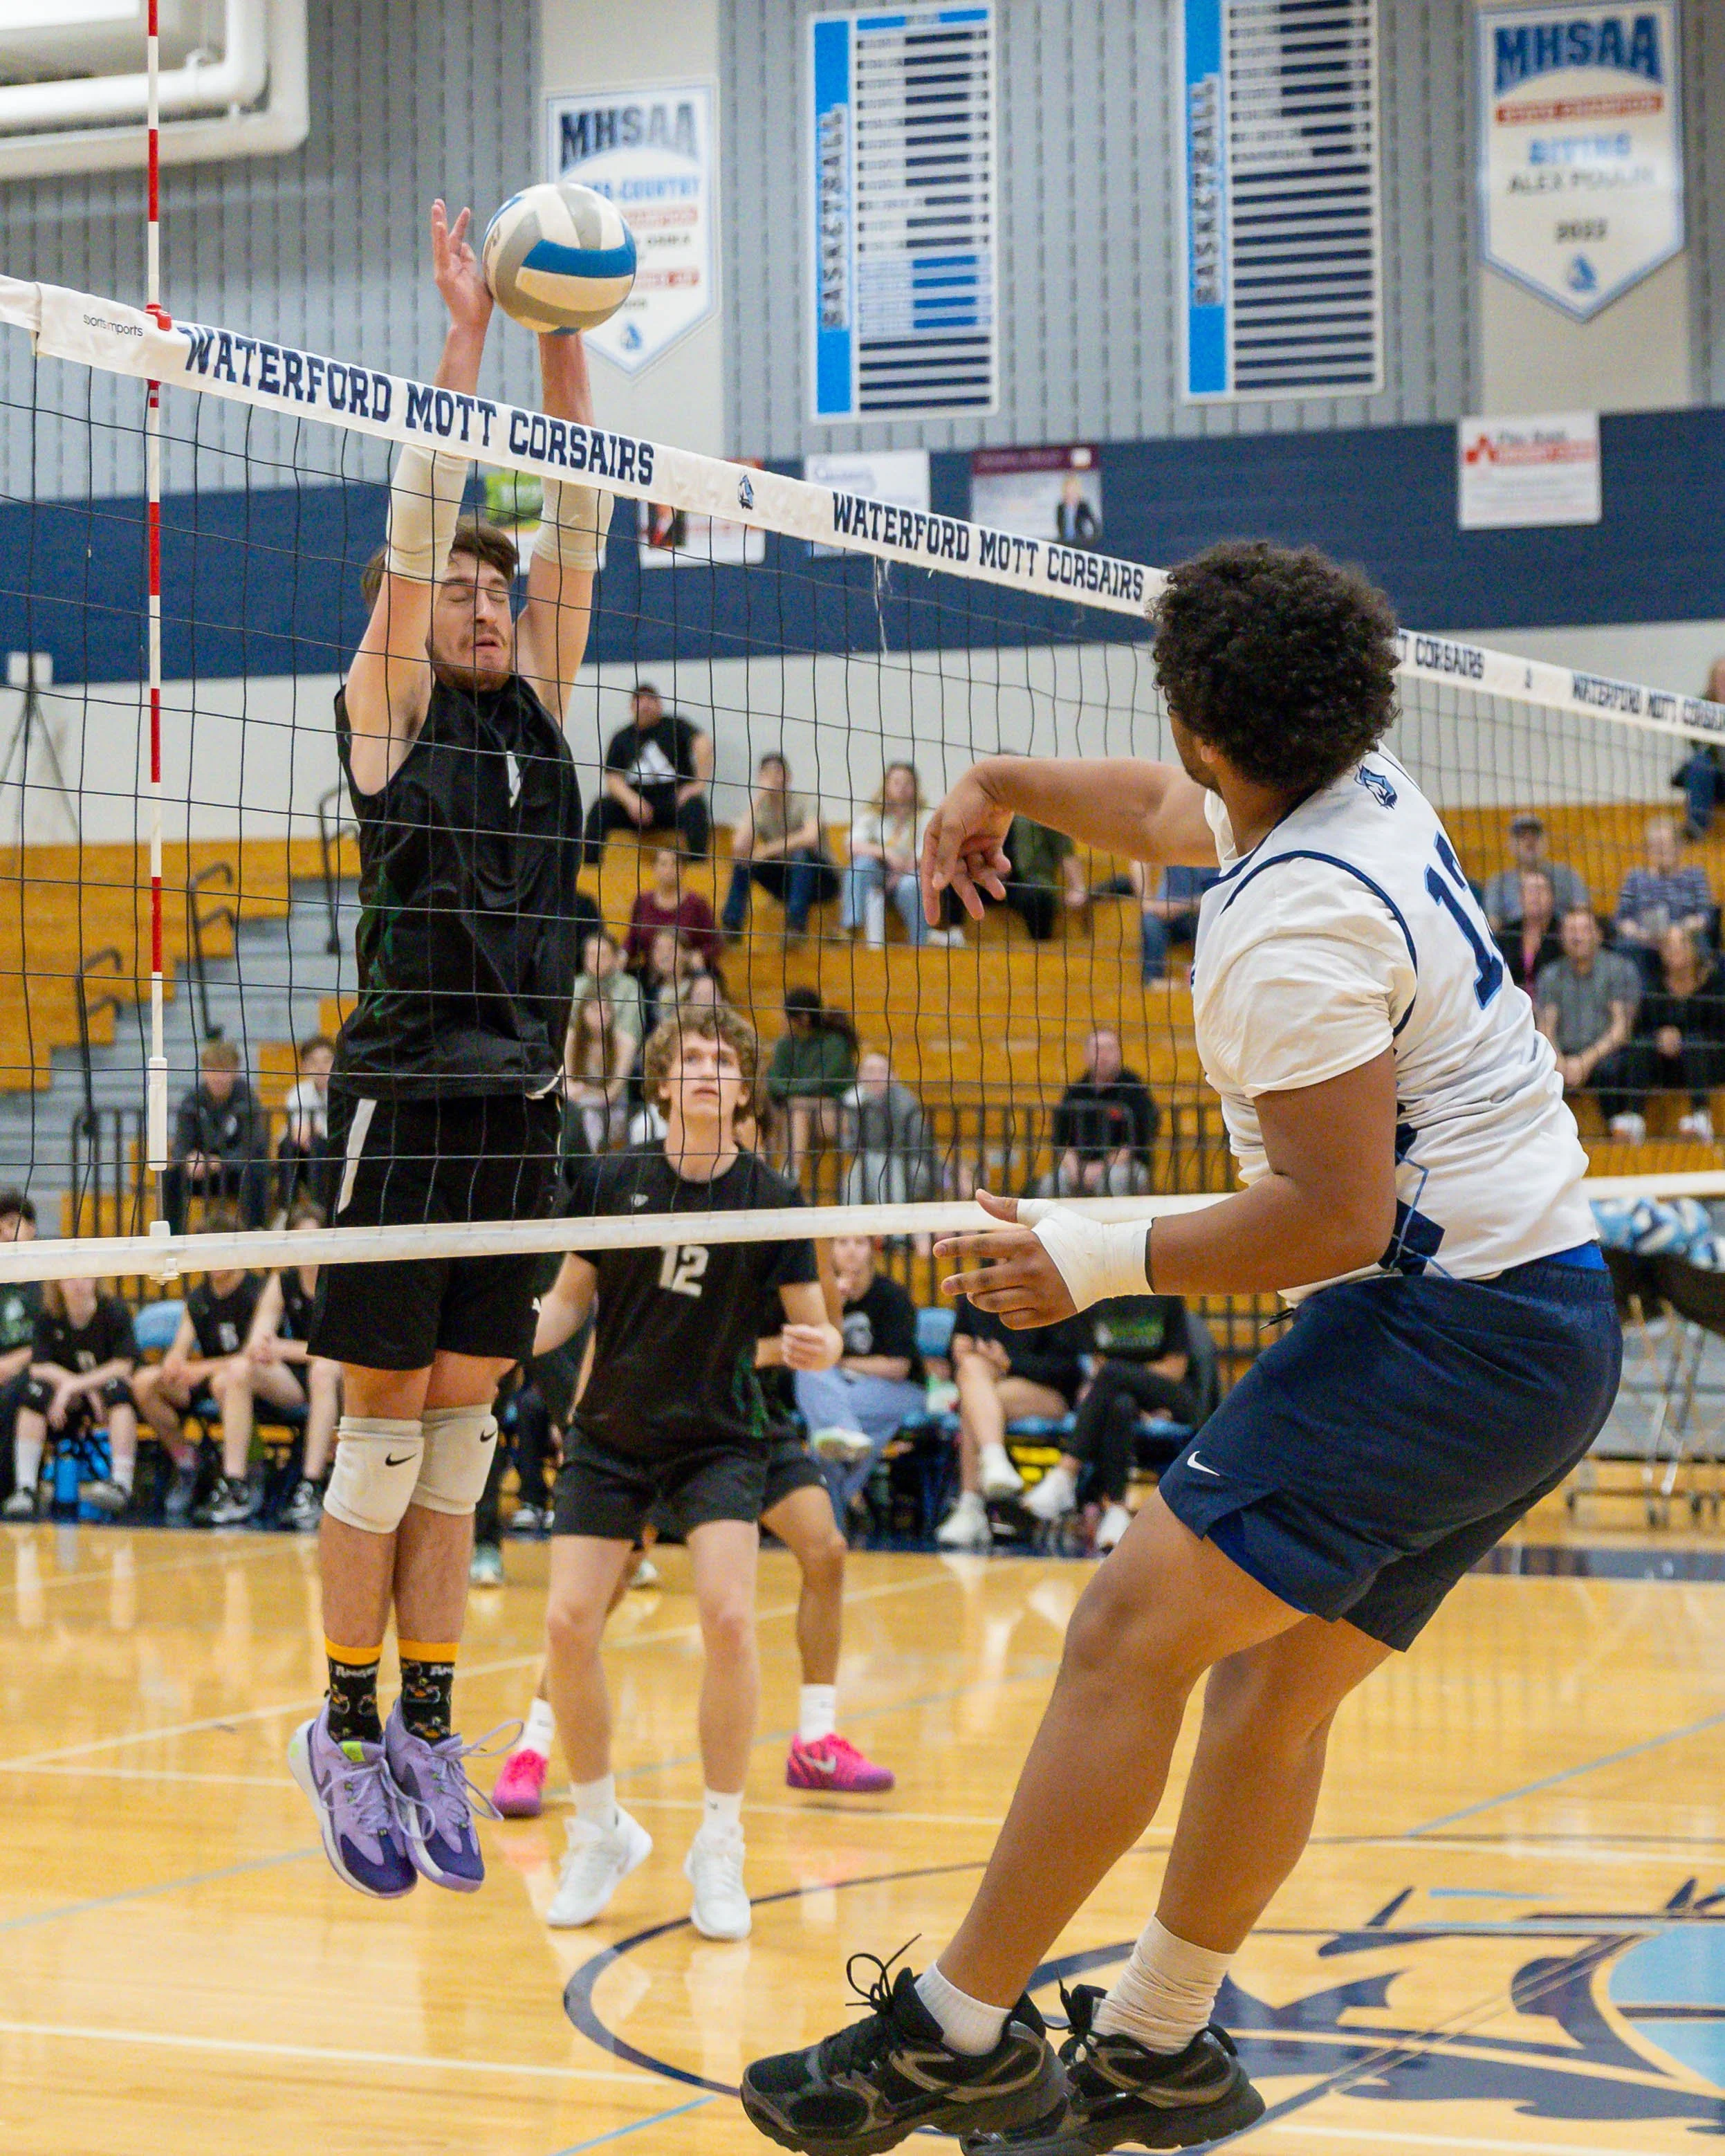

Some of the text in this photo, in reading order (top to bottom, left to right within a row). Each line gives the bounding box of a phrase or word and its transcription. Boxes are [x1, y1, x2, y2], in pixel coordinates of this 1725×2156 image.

[1495, 15, 1664, 98] MHSAA
[560, 101, 701, 174] MHSAA
[176, 326, 654, 486] WATERFORD MOTT CORSAIRS
[832, 492, 970, 562] WATERFORD
[979, 529, 1040, 577] MOTT
[1047, 547, 1145, 602] CORSAIRS
[1415, 638, 1484, 679] CORSAIRS
[658, 1244, 709, 1298] 12
